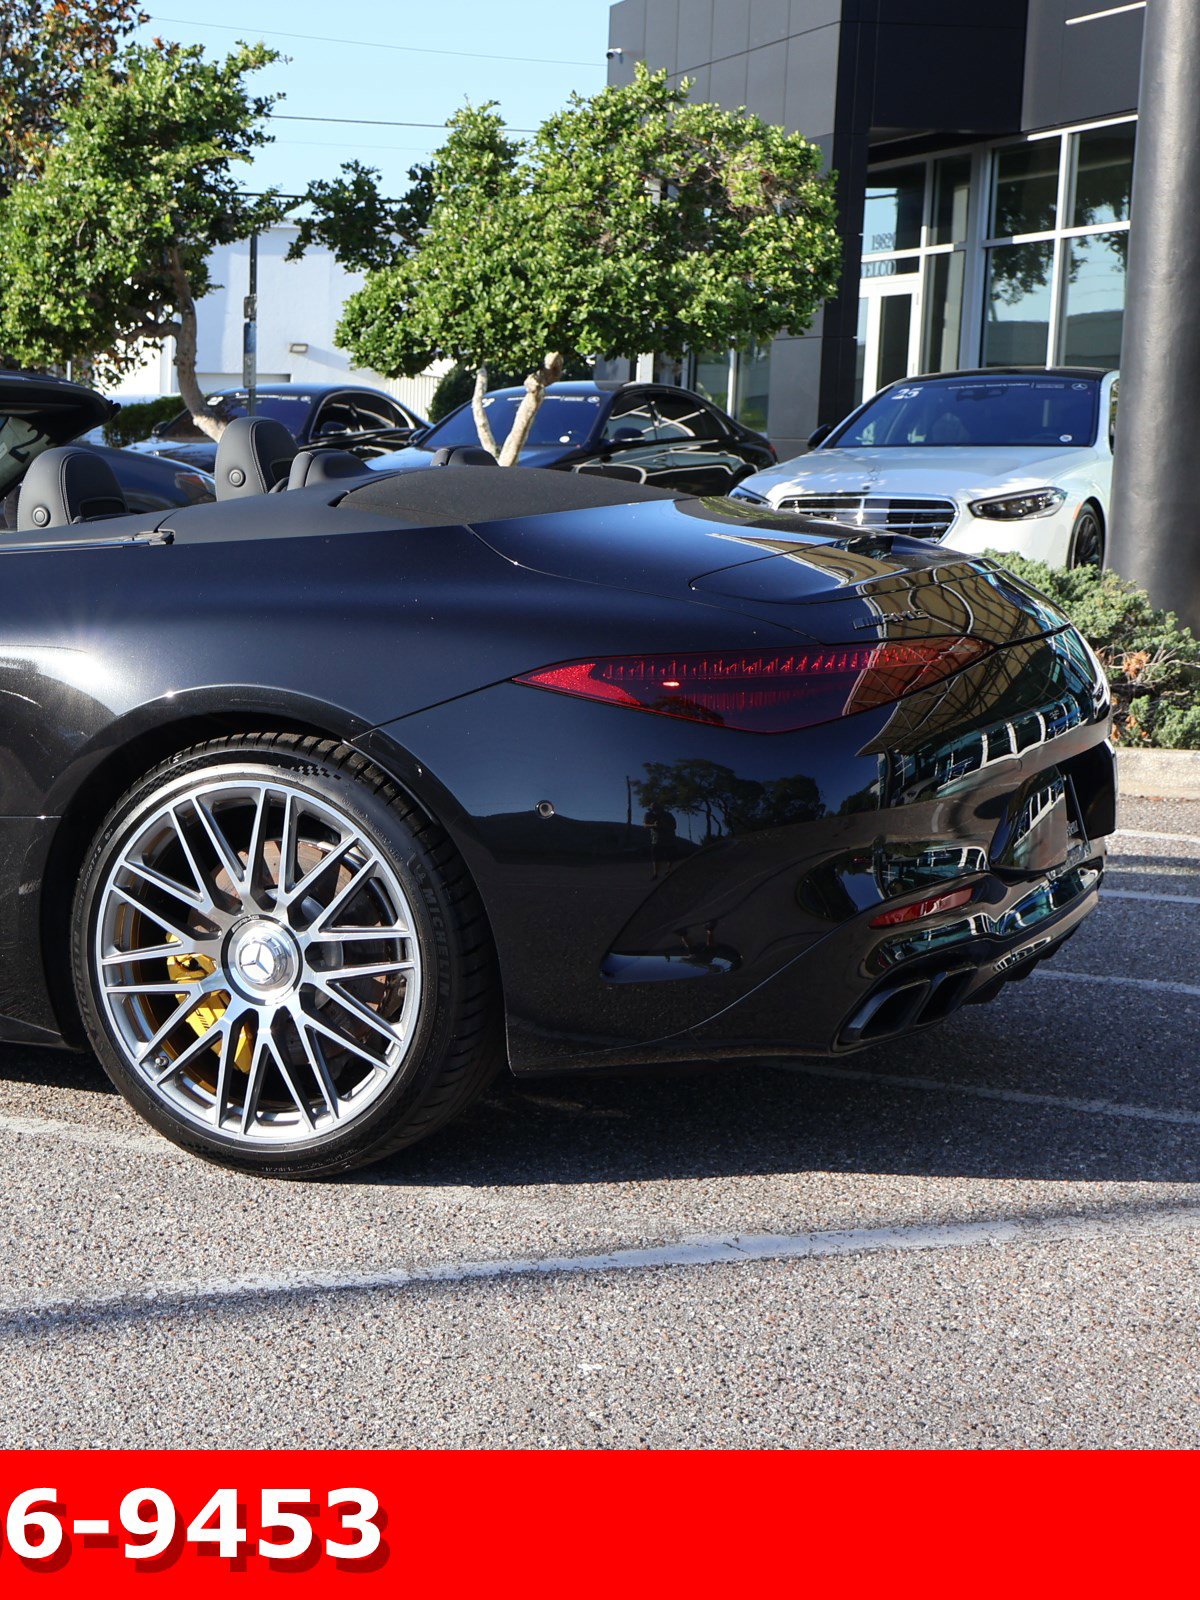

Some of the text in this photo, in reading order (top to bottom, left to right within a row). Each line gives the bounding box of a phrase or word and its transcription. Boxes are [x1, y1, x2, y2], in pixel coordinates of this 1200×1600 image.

[891, 387, 923, 400] 25
[82, 860, 97, 894] SPORT
[422, 887, 451, 998] MICHELIN
